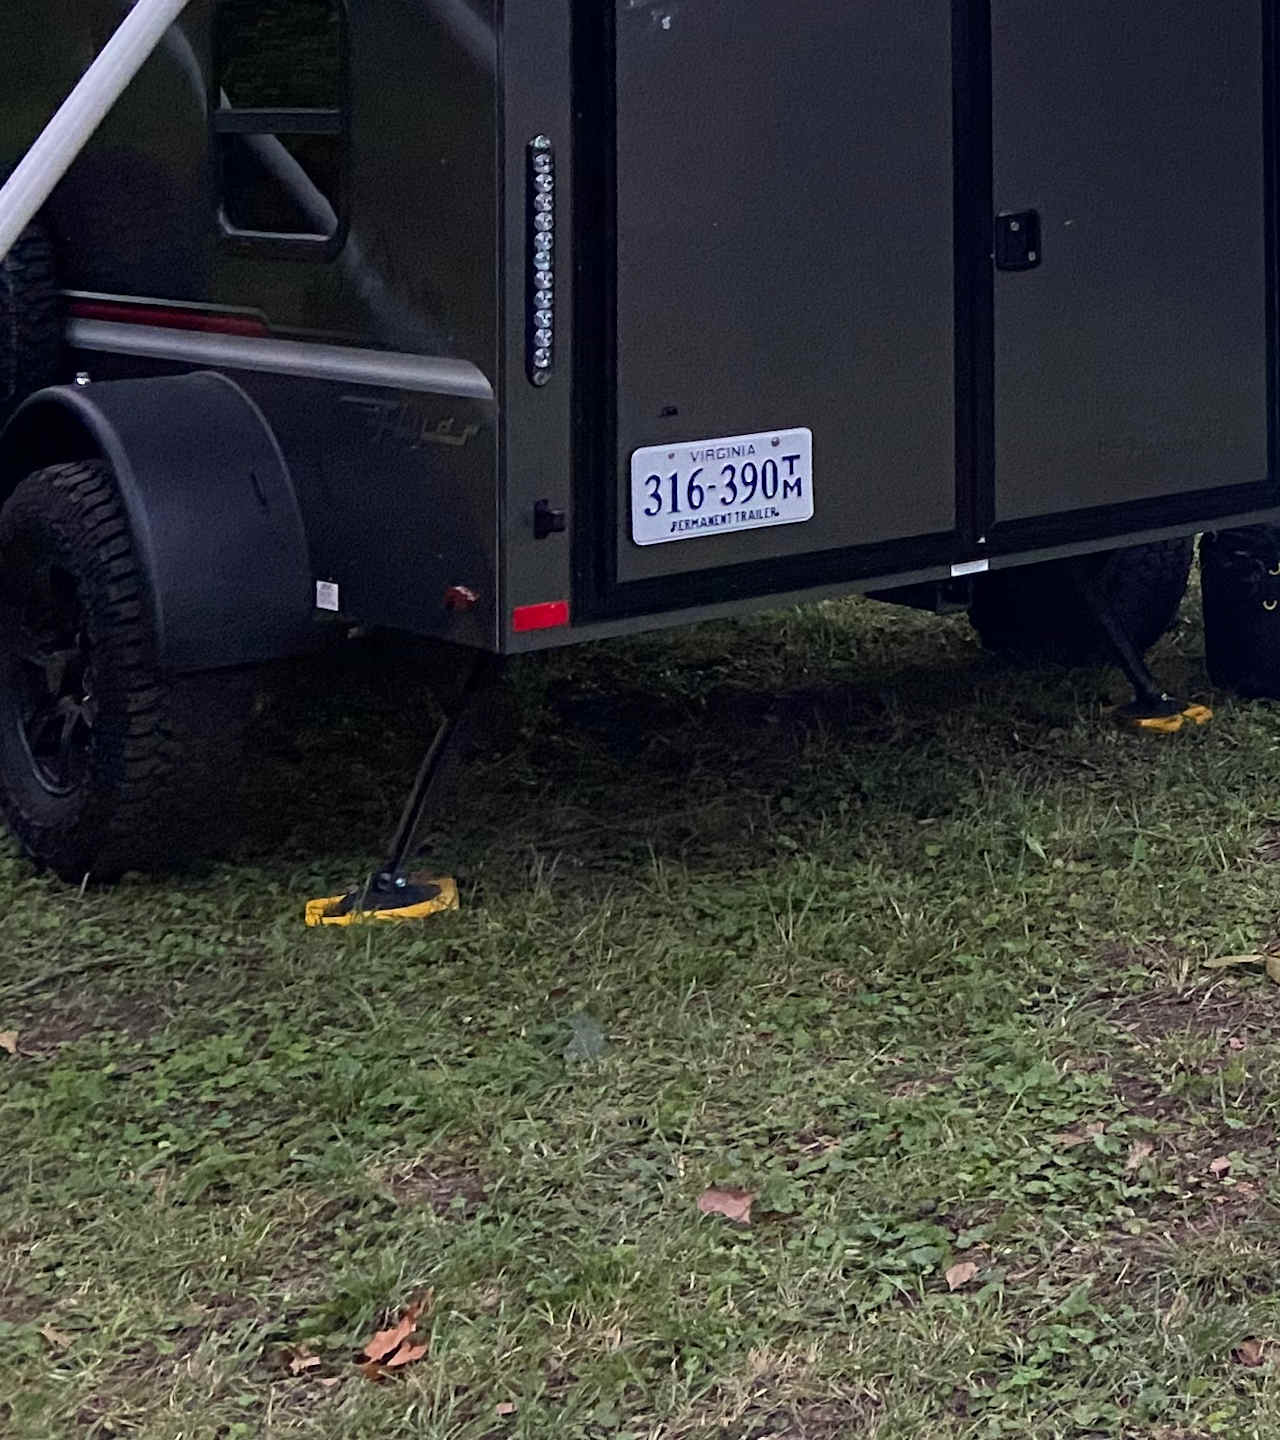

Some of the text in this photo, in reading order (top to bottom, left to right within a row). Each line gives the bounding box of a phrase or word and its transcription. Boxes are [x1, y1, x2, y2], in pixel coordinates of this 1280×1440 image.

[690, 444, 756, 462] VIRGINIA
[670, 506, 777, 533] PERMANENT TRAILER
